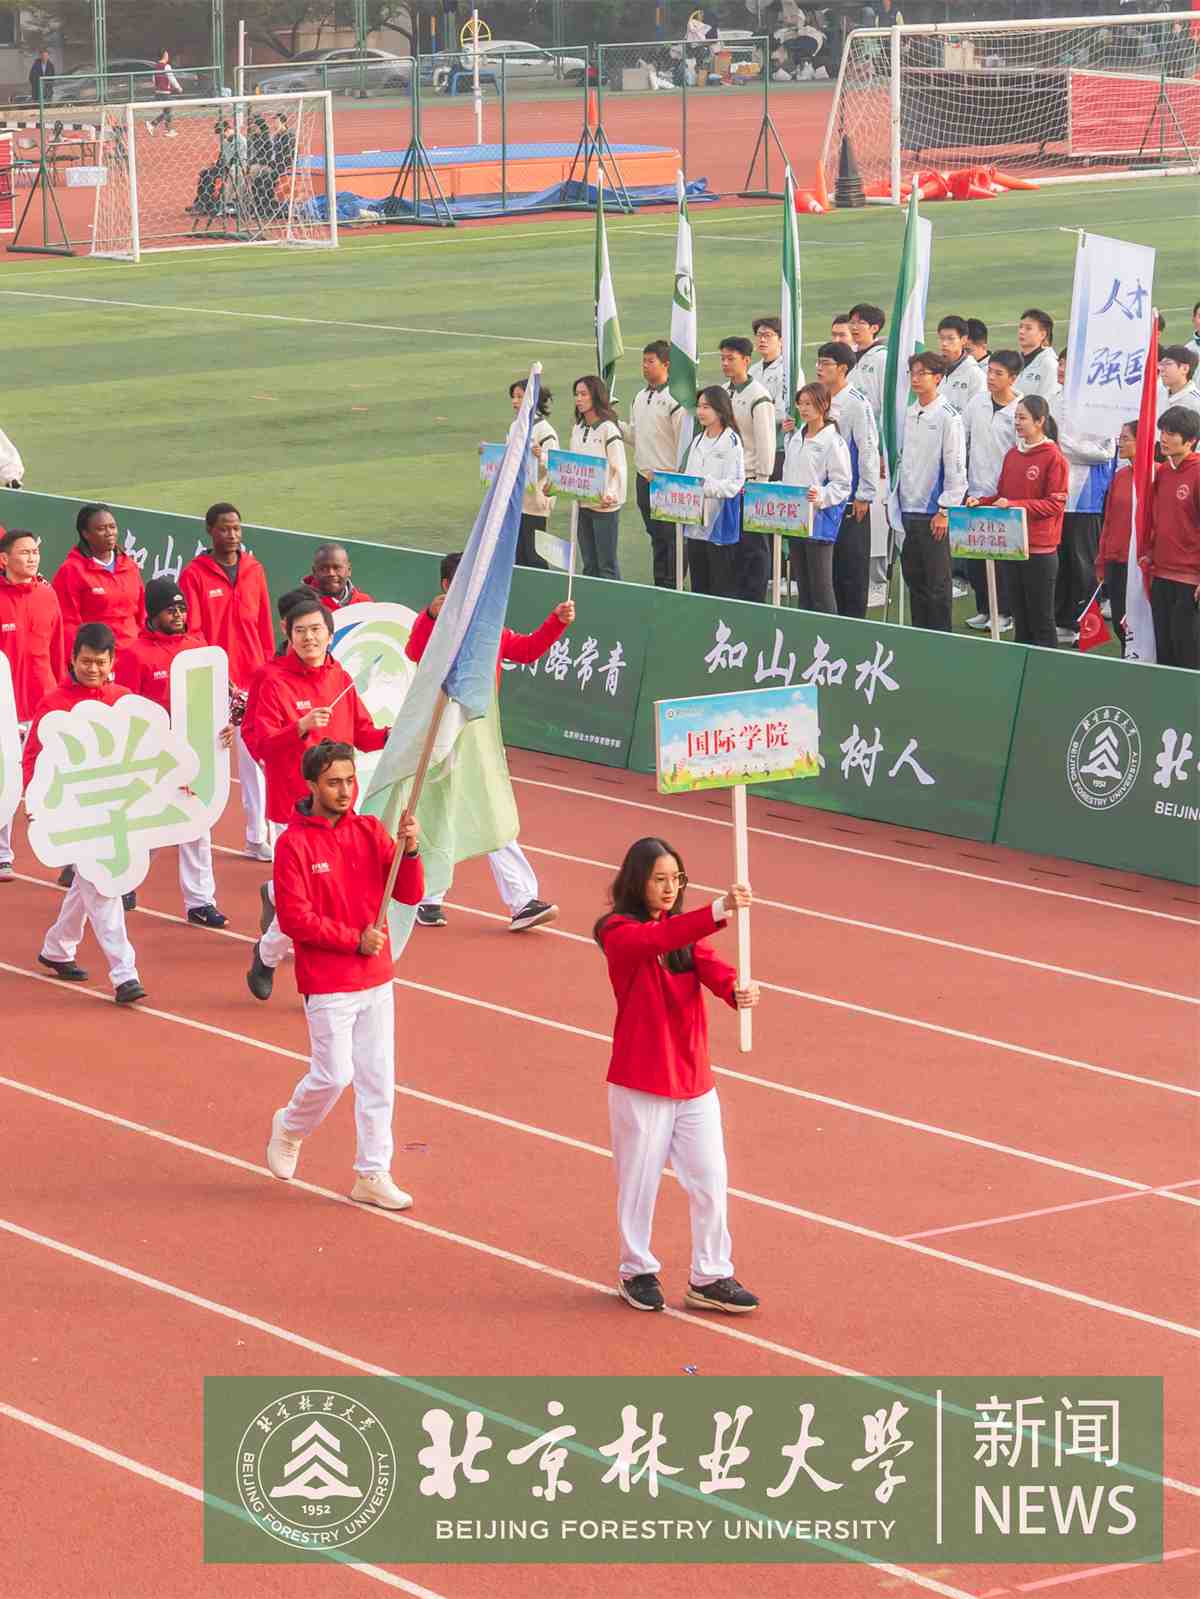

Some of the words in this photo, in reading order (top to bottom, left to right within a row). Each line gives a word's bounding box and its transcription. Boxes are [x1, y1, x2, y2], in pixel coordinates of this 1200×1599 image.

[1091, 277, 1149, 320] 人才
[1086, 346, 1145, 390] 强国
[755, 499, 800, 519] 信息学院
[123, 528, 208, 584] 知山
[703, 619, 900, 705] 知山知水
[686, 721, 791, 758] 国际学院
[818, 723, 936, 787] 树人
[1153, 728, 1200, 789] 北
[43, 715, 191, 879] 学
[1154, 801, 1200, 822] BEIJIN
